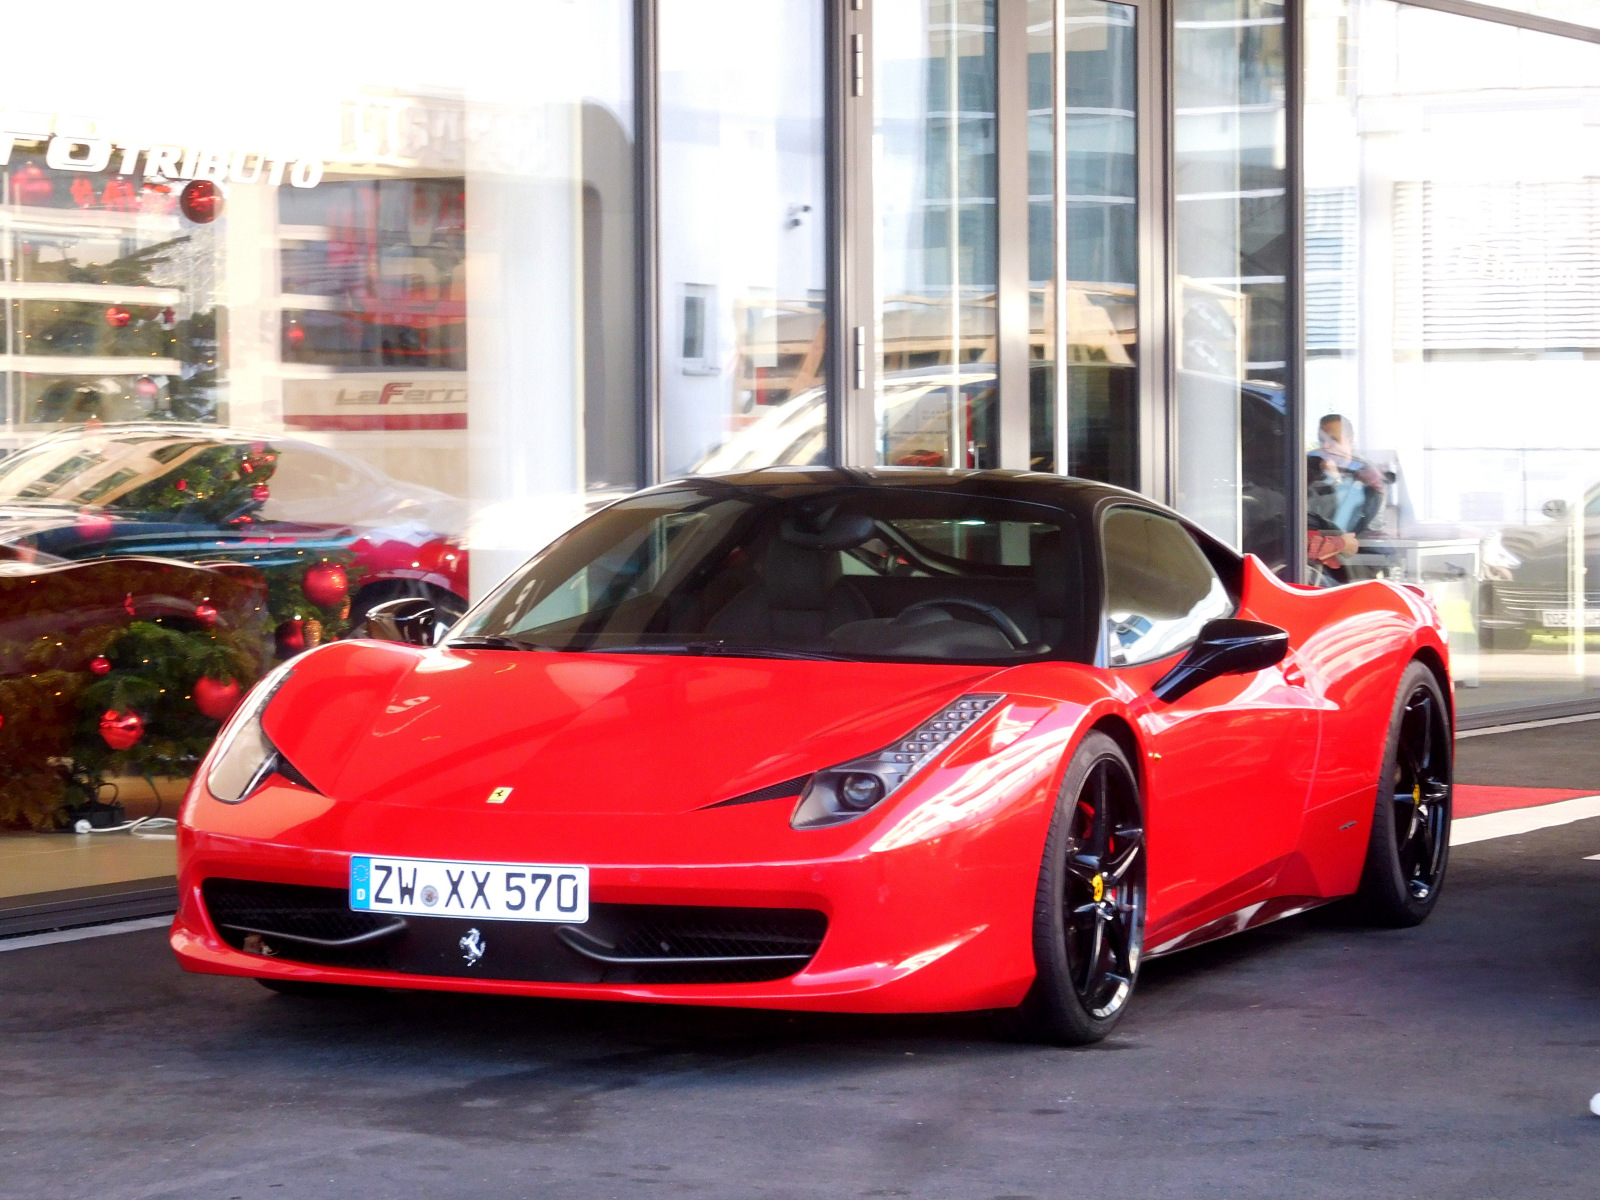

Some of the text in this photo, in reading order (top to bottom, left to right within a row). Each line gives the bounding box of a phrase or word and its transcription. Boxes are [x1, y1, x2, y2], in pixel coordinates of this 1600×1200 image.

[111, 142, 324, 188] TRIBUTO
[335, 382, 467, 404] LaFerr
[374, 865, 417, 905] ZW
[445, 869, 491, 910] XX
[505, 872, 578, 913] 570
